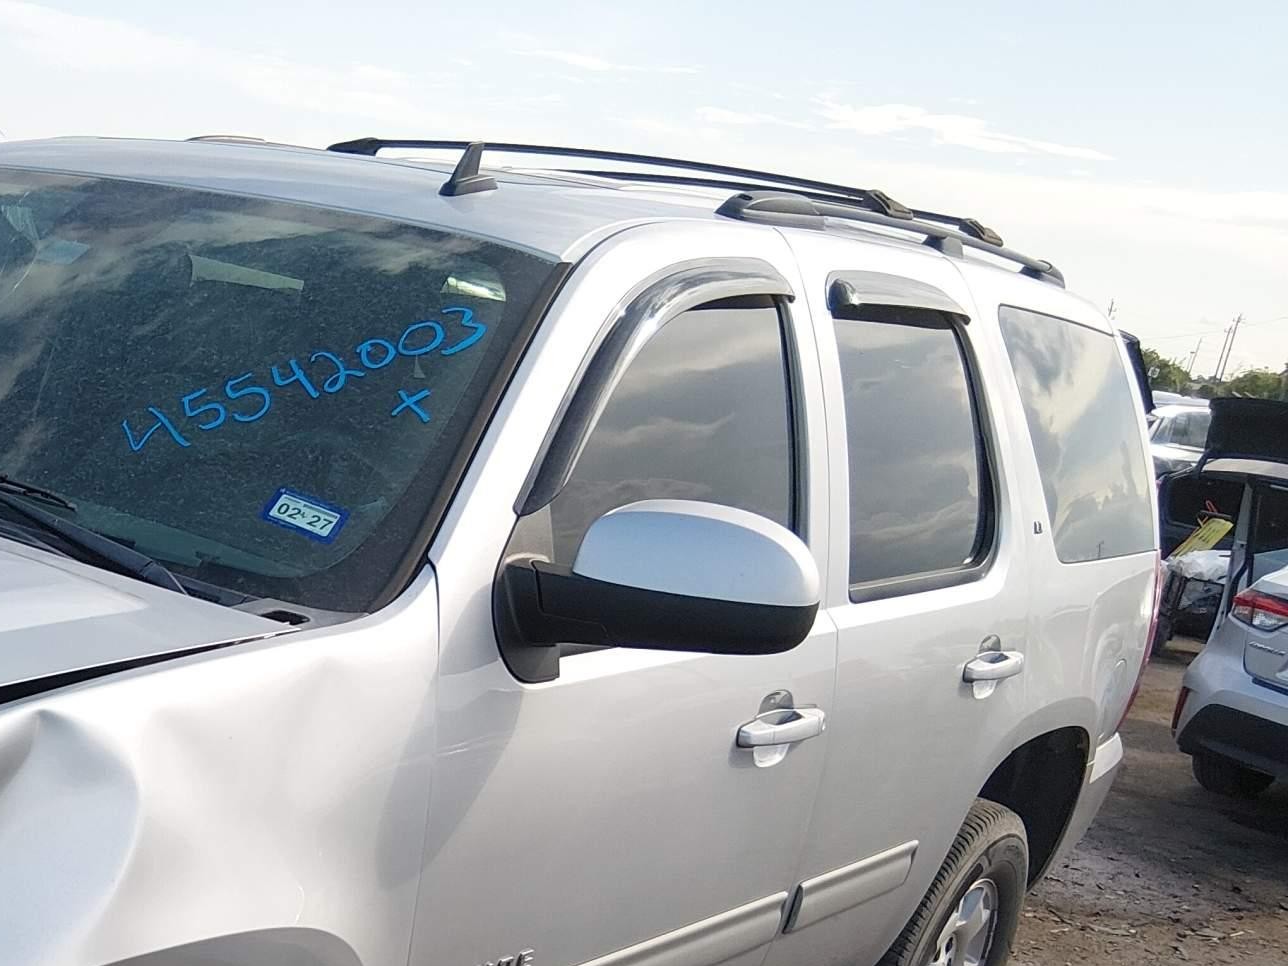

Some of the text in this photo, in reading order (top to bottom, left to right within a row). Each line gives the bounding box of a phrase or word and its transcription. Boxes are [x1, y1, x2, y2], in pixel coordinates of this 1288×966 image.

[122, 307, 487, 453] 45542003
[277, 503, 302, 520] 02
[306, 514, 334, 531] 27
